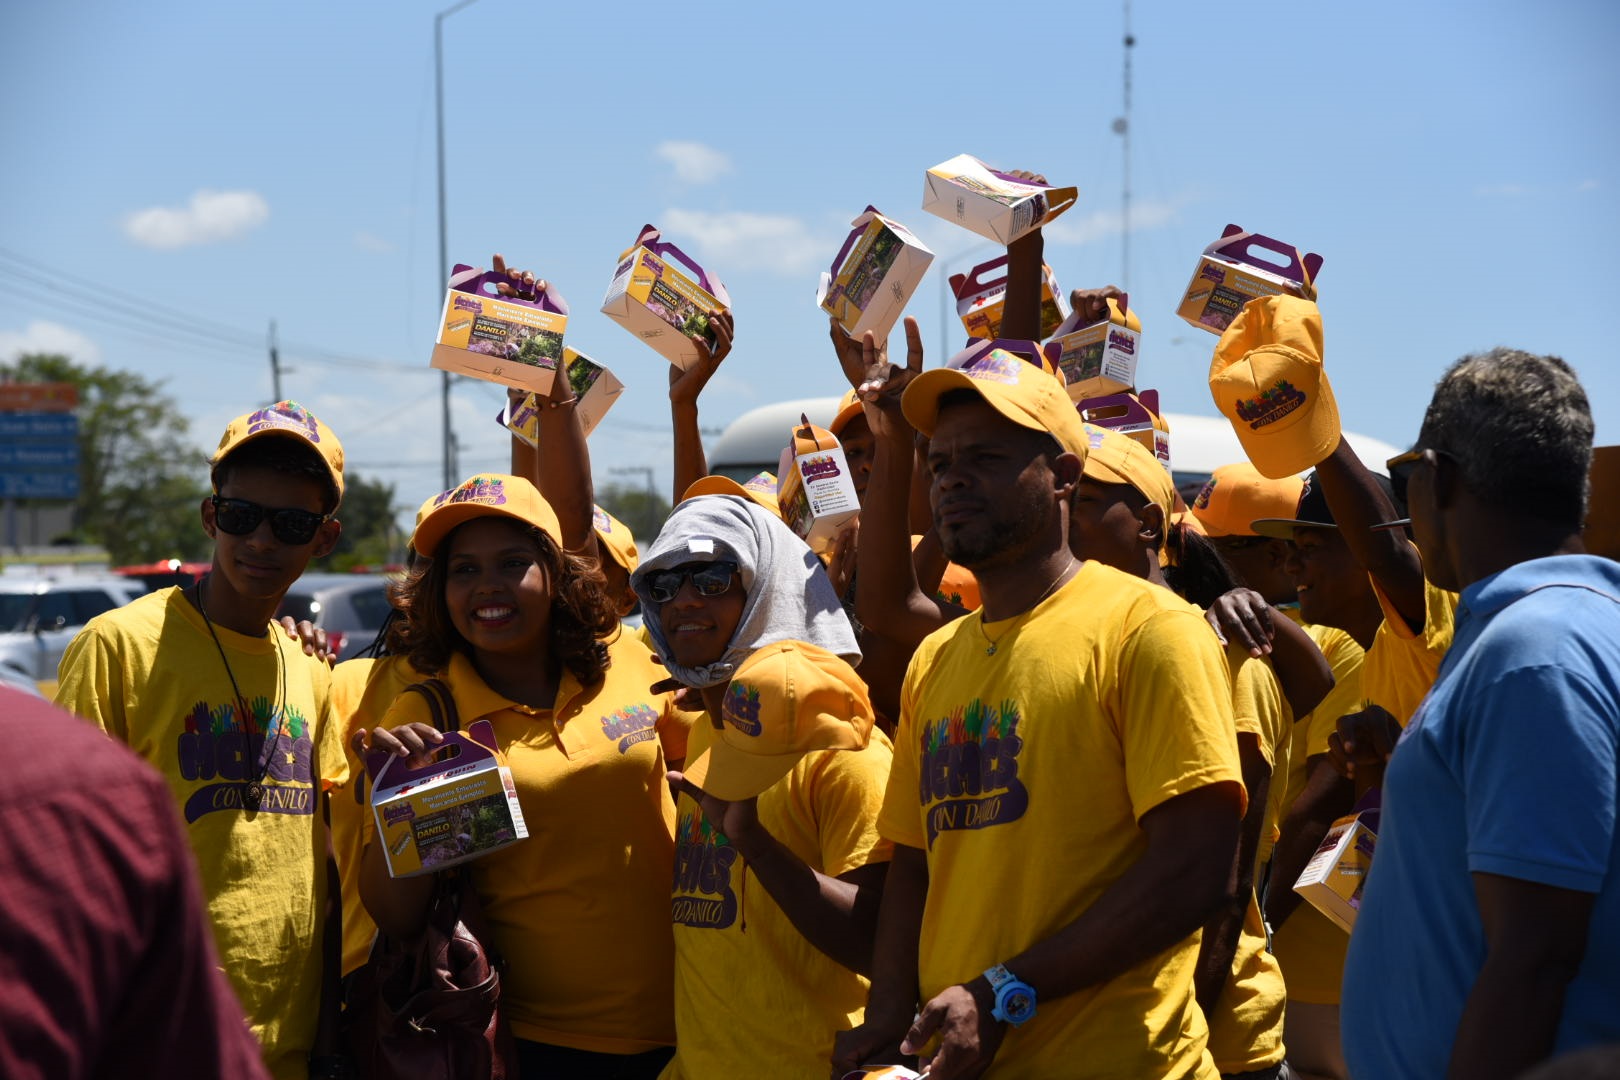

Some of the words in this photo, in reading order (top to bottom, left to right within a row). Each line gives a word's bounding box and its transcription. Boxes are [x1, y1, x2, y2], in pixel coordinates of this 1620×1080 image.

[654, 286, 677, 306] DANILO
[1212, 295, 1238, 309] DANILO
[474, 324, 507, 336] DANILO
[259, 788, 309, 810] ANILO
[965, 798, 1001, 827] DANILO
[417, 822, 451, 839] DANILO
[682, 901, 724, 922] DANILO
